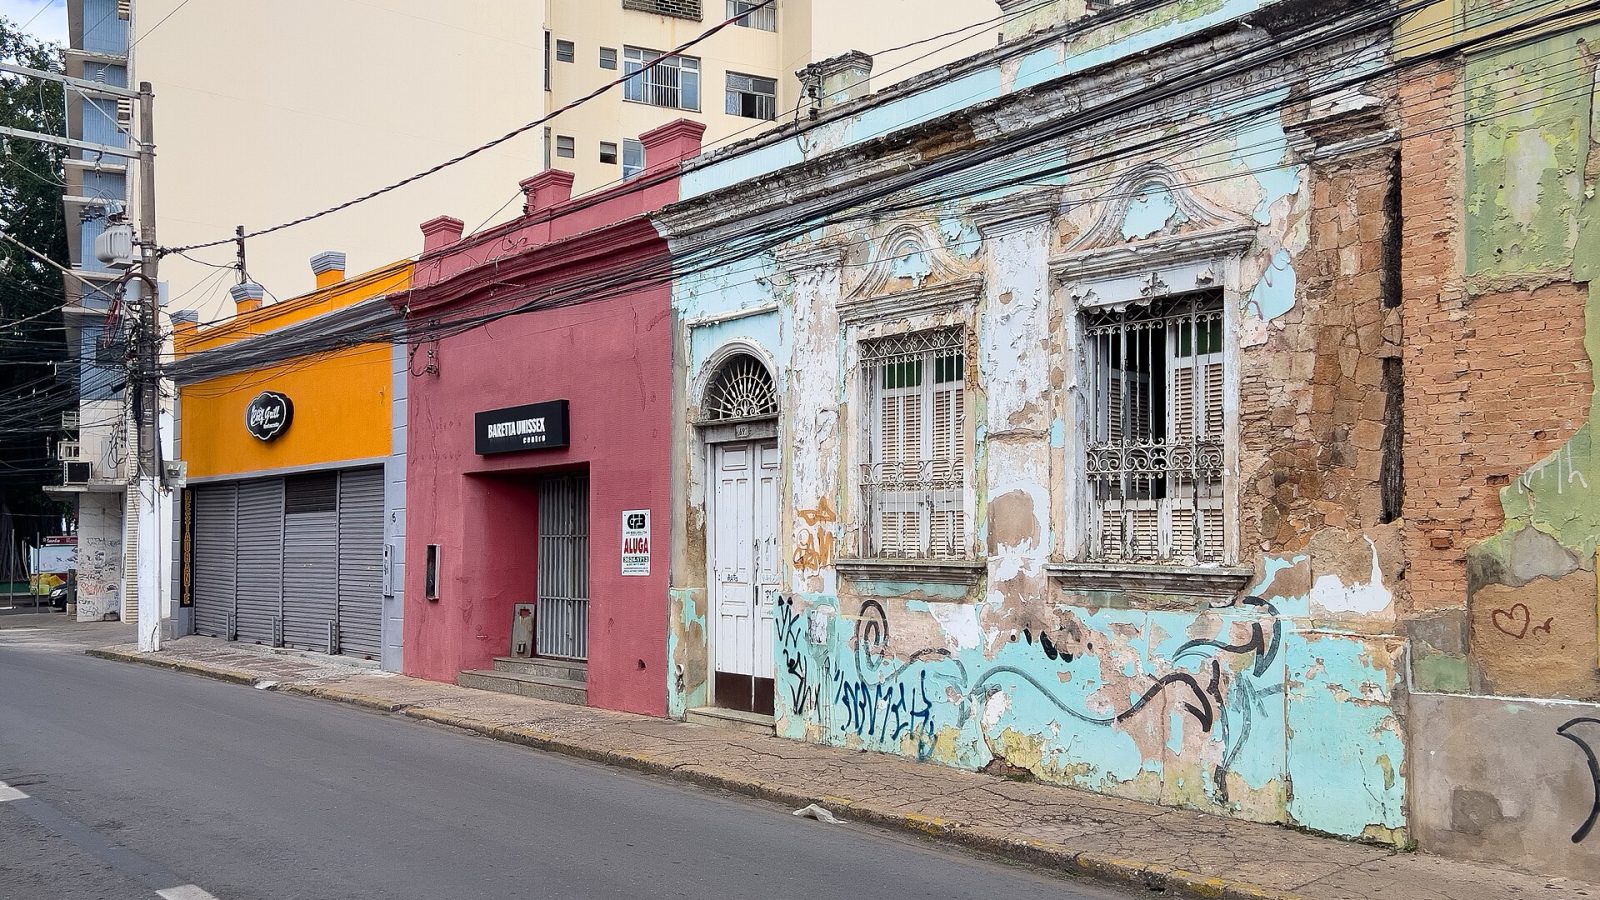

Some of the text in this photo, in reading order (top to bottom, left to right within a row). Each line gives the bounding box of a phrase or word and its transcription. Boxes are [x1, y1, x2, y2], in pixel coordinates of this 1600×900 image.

[488, 417, 545, 439] BARETTA UNISSEX
[183, 489, 192, 605] RESTAURANTE
[624, 537, 649, 554] ALUGA
